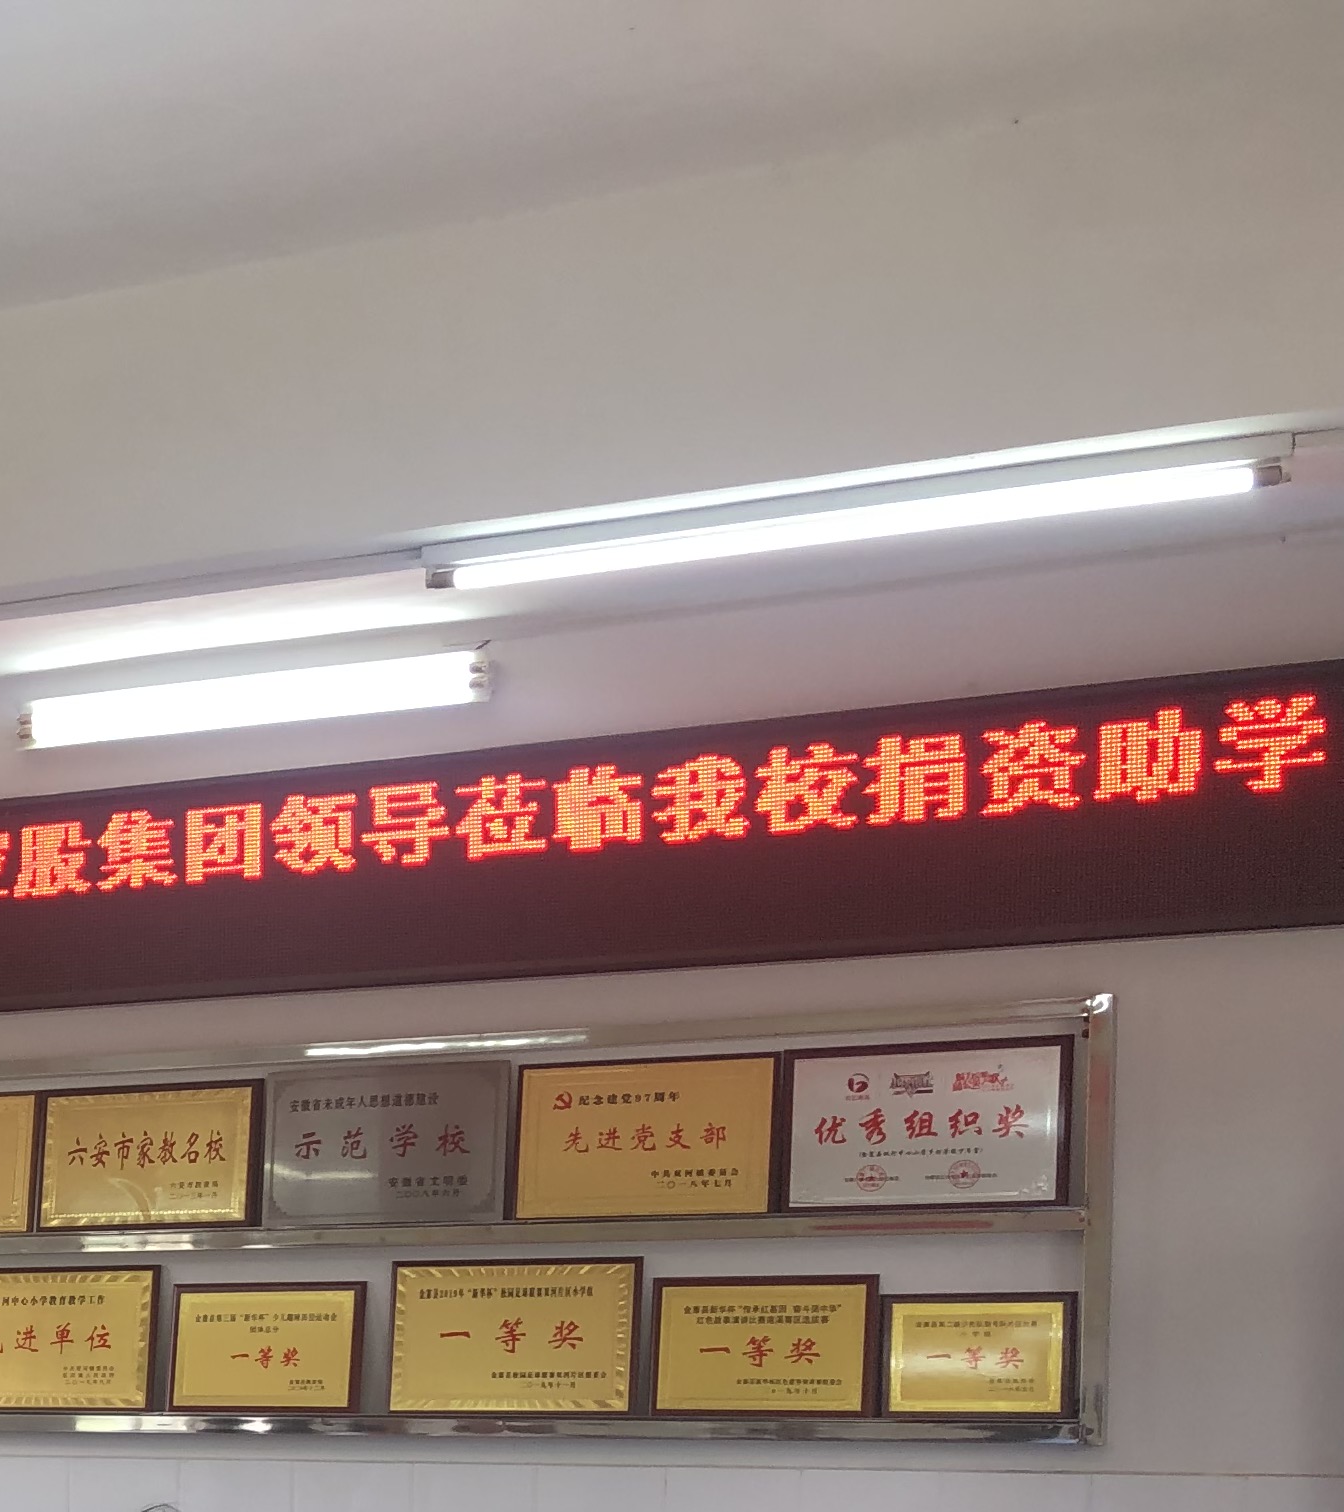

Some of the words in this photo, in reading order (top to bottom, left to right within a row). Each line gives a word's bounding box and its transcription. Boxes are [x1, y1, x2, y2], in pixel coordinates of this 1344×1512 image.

[578, 1091, 680, 1106] 纪念建党97周年
[563, 1122, 727, 1154] 先进党支部
[814, 1103, 1029, 1146] 优秀组织奖
[67, 1129, 226, 1170] 六安市家教名校
[294, 1123, 470, 1160] 示范学校
[439, 1316, 584, 1354] 一等奖
[699, 1335, 821, 1368] 一等奖
[230, 1345, 301, 1369] 一等奖
[926, 1345, 1024, 1370] 一等奖
